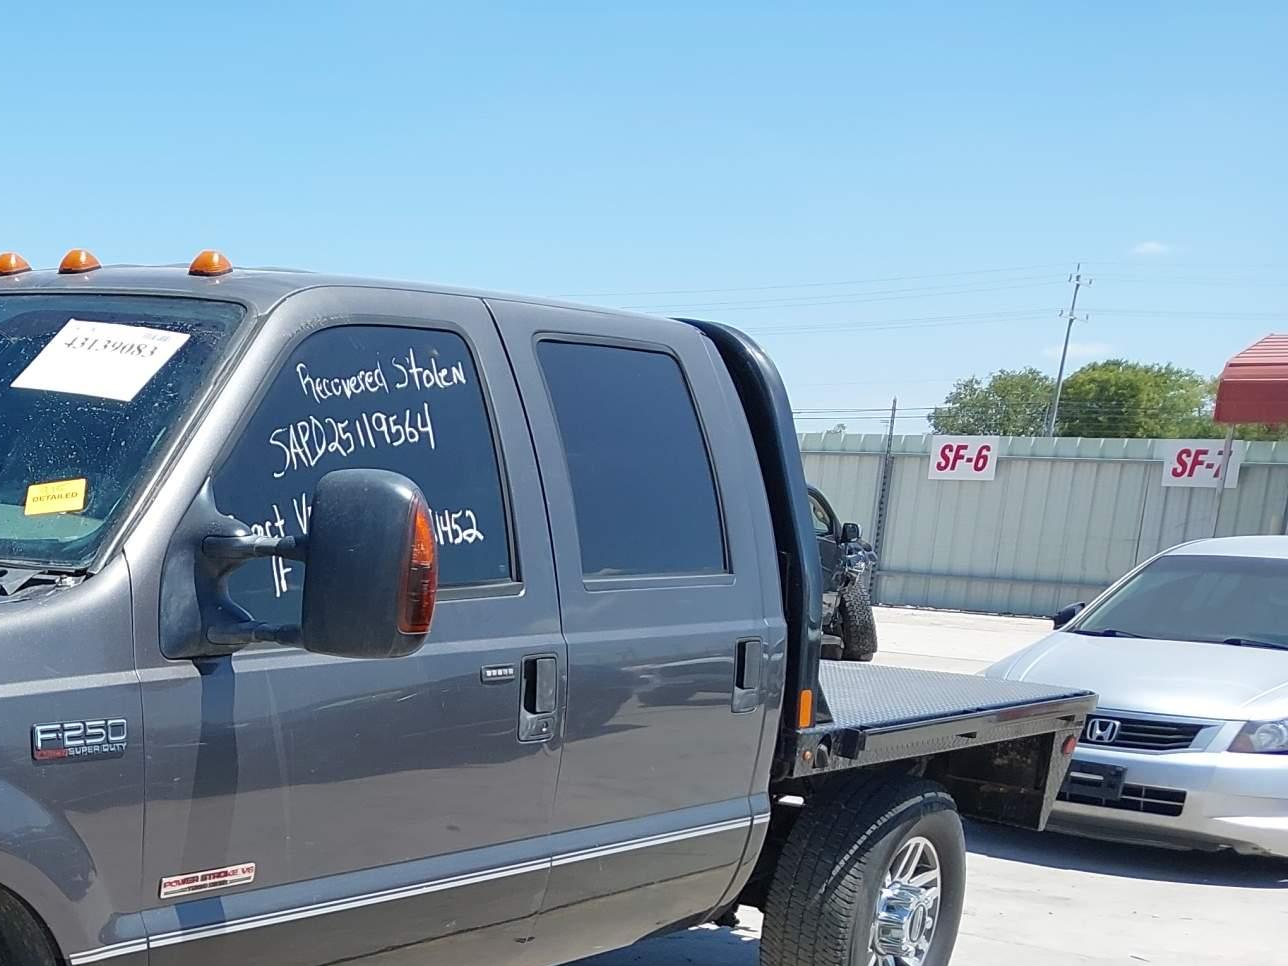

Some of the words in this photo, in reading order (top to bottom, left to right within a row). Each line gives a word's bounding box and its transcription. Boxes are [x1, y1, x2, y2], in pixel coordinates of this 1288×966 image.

[64, 335, 159, 358] 43139083
[296, 359, 390, 404] Recovered
[392, 347, 467, 391] Stolen
[269, 402, 436, 478] SAPD25119564
[935, 443, 992, 473] SF-6
[32, 491, 79, 503] DETAILED
[67, 747, 100, 756] SUPER
[101, 742, 128, 753] DUTY
[163, 875, 199, 888] POWER
[200, 868, 239, 882] STROKE
